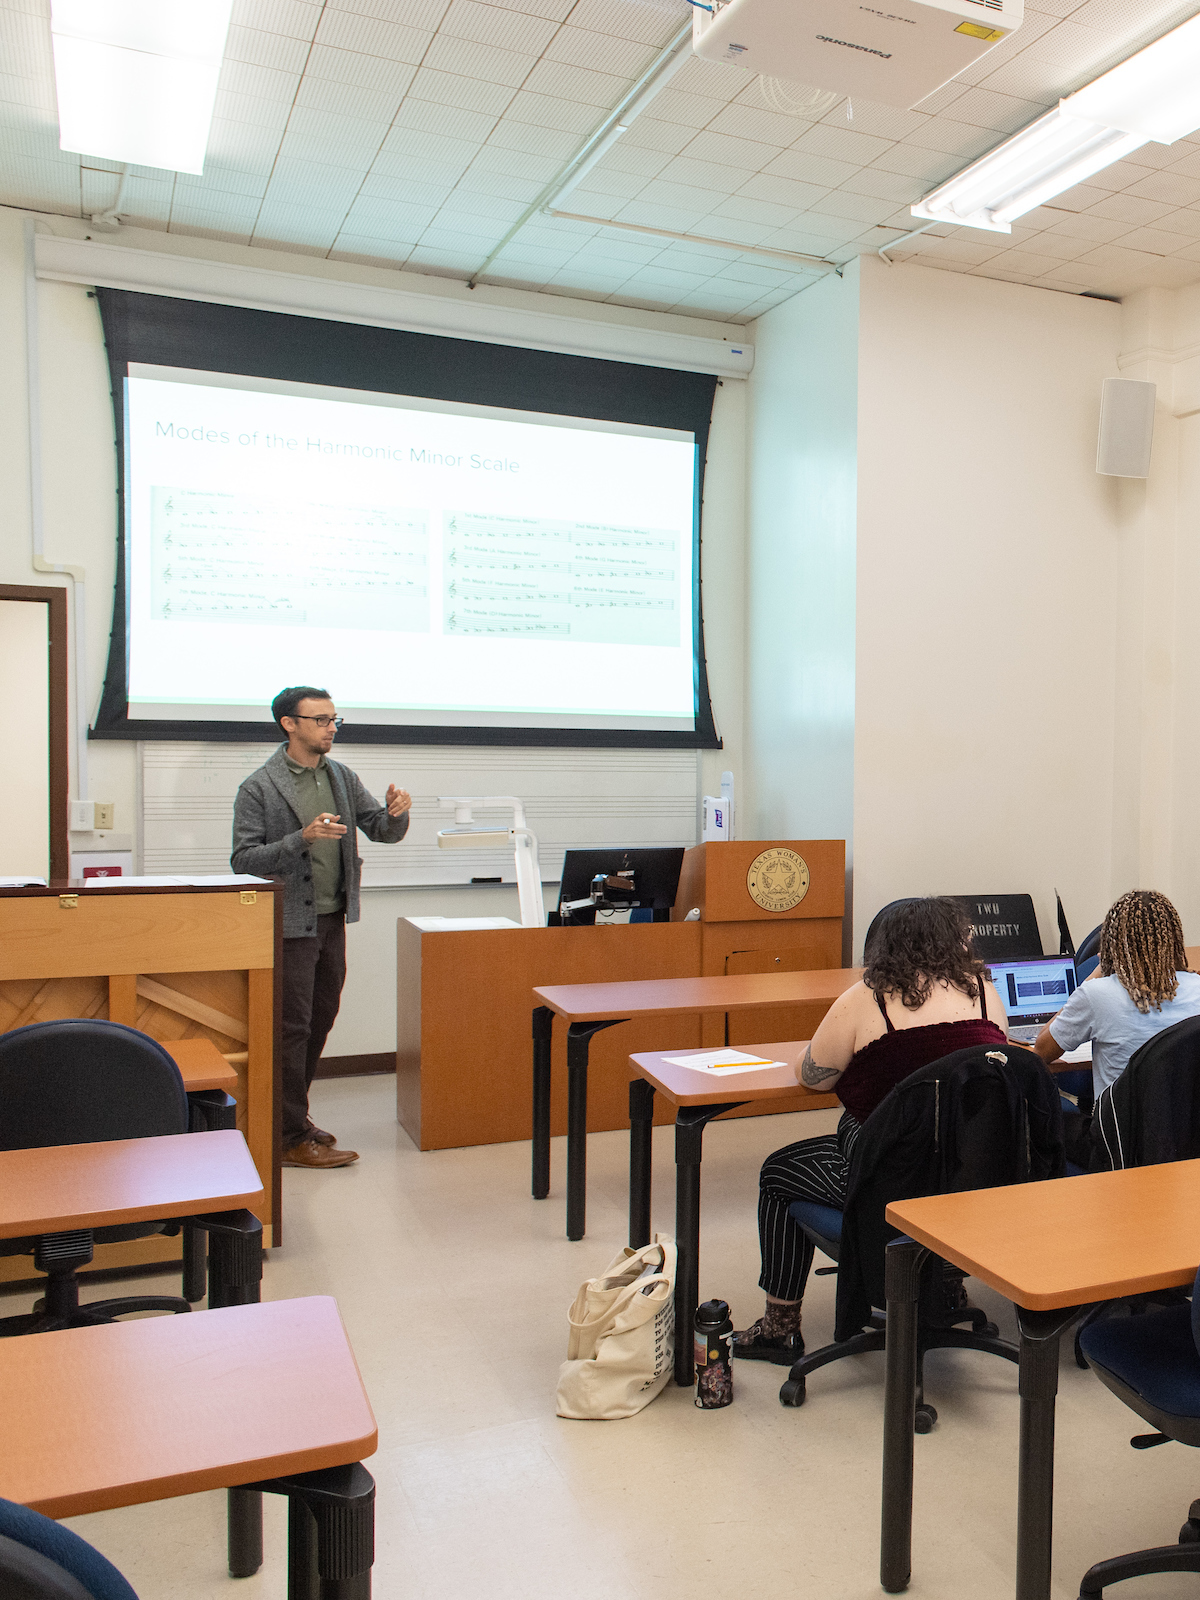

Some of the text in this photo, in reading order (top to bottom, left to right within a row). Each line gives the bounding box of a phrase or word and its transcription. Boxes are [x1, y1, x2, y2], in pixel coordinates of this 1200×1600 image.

[816, 35, 892, 59] Panasonic
[156, 421, 520, 473] Modes of the Harmonic Minor Scale
[752, 851, 806, 874] TEXAS WOMAN'S
[756, 893, 801, 909] UNIVERSITY
[976, 903, 1000, 914] TWU
[972, 924, 1019, 936] ROPERTY
